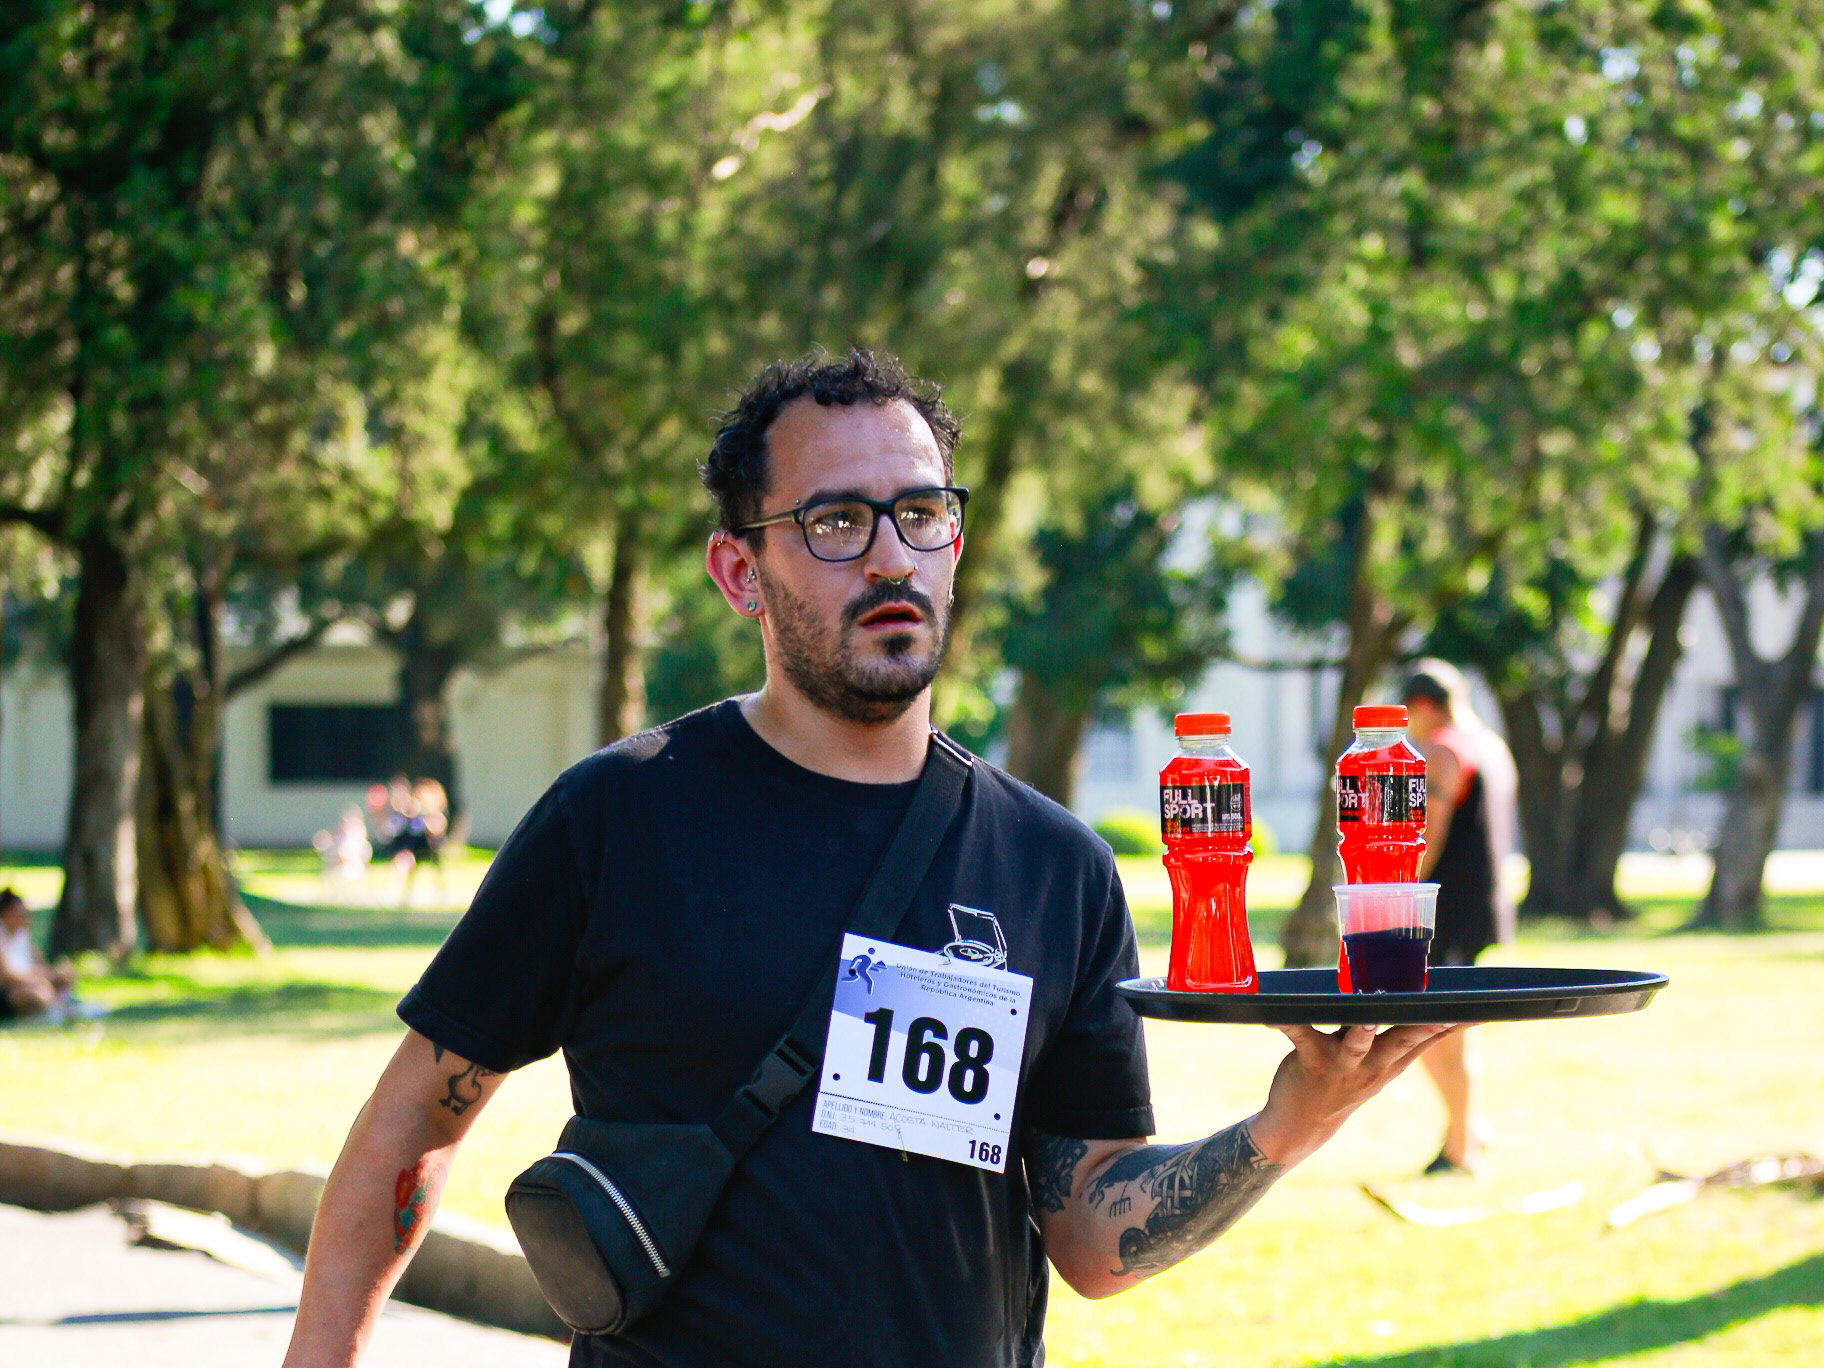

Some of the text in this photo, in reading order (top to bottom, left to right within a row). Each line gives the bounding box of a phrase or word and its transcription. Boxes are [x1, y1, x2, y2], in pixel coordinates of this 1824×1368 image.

[1163, 789, 1199, 805] FULL
[1163, 803, 1216, 819] SPORT
[896, 963, 917, 973] Unión
[931, 970, 977, 987] Trabajadores
[900, 972, 936, 985] Hoteleros
[943, 981, 997, 999] Gastronómicos
[920, 984, 994, 1006] República Argentina
[863, 1007, 995, 1105] 168
[822, 1099, 853, 1114] APELLIDO
[968, 1139, 1002, 1165] 168
